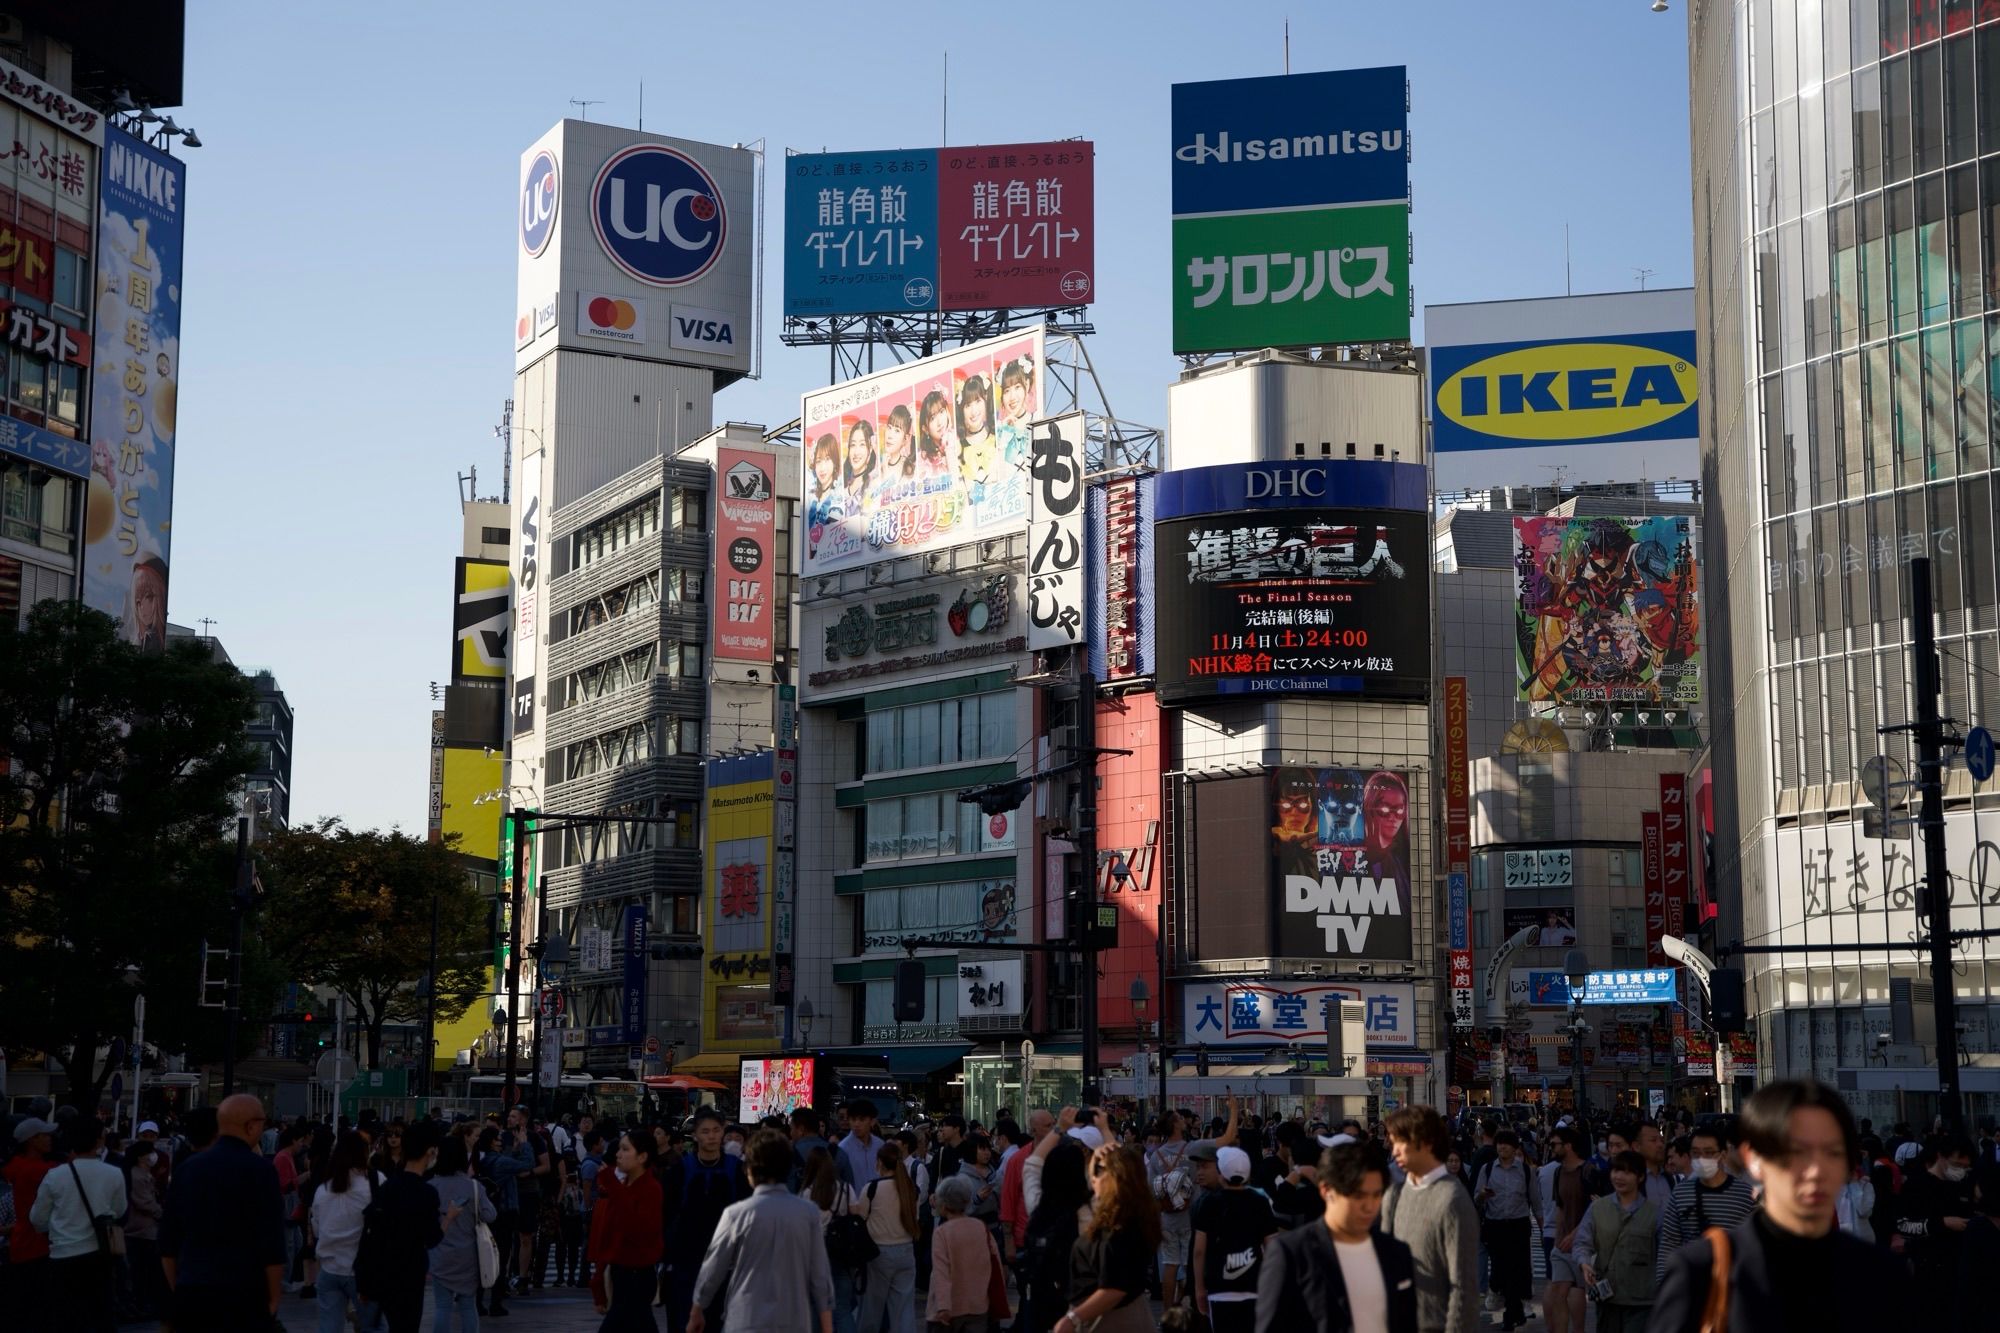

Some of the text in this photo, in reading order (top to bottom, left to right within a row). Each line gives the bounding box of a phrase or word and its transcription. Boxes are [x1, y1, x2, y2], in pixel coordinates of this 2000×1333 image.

[950, 152, 1085, 170] のど、直接、うるおう
[1176, 129, 1402, 165] Hisamitsu
[109, 140, 176, 214] NIKKE
[796, 159, 930, 178] のど、直接、うるおう
[818, 184, 907, 226] 龍角散
[972, 177, 1063, 220] 龍角散
[804, 228, 924, 270] ダイレクト
[960, 221, 1080, 262] ダイレクト
[818, 272, 865, 285] スティック
[974, 266, 1021, 279] スティック
[1062, 278, 1089, 292] 生薬
[1187, 246, 1394, 309] サロンパス
[906, 285, 931, 299] 生薬
[10, 308, 79, 362] ガスト
[590, 328, 634, 340] mastercard
[674, 316, 733, 344] VISA
[118, 218, 152, 556] 1周年ありがとう
[1461, 364, 1687, 417] IKEA
[1245, 468, 1327, 498] DHC
[1029, 421, 1081, 640] もんじゃ
[1186, 525, 1405, 585] 進撃の巨人
[729, 579, 760, 600] B1F
[1238, 592, 1353, 604] The Final Season
[729, 602, 762, 623] B2F
[1245, 608, 1334, 627] 完結編(後編)
[1211, 629, 1368, 651] 11月4日(土)24:00
[1188, 651, 1394, 676] NHK総合にてスペシャル放送
[1251, 678, 1328, 691] DHC Channel
[518, 693, 532, 717] 7F
[1450, 682, 1464, 799] クスリのことなら
[712, 796, 754, 808] Matsumoto
[1664, 787, 1685, 885] カラオケ
[1523, 852, 1571, 867] れいわ
[1646, 826, 1657, 881] BIG ECHO
[721, 861, 760, 918] 薬
[1507, 870, 1571, 885] クリニック
[1805, 840, 2000, 916] 好きなの
[1285, 874, 1401, 915] DMM
[1669, 896, 1681, 921] BIG
[1317, 915, 1371, 953] TV
[1453, 955, 1471, 987] 焼肉
[1456, 988, 1472, 1021] 牛繁
[1226, 1247, 1255, 1269] NIKE
